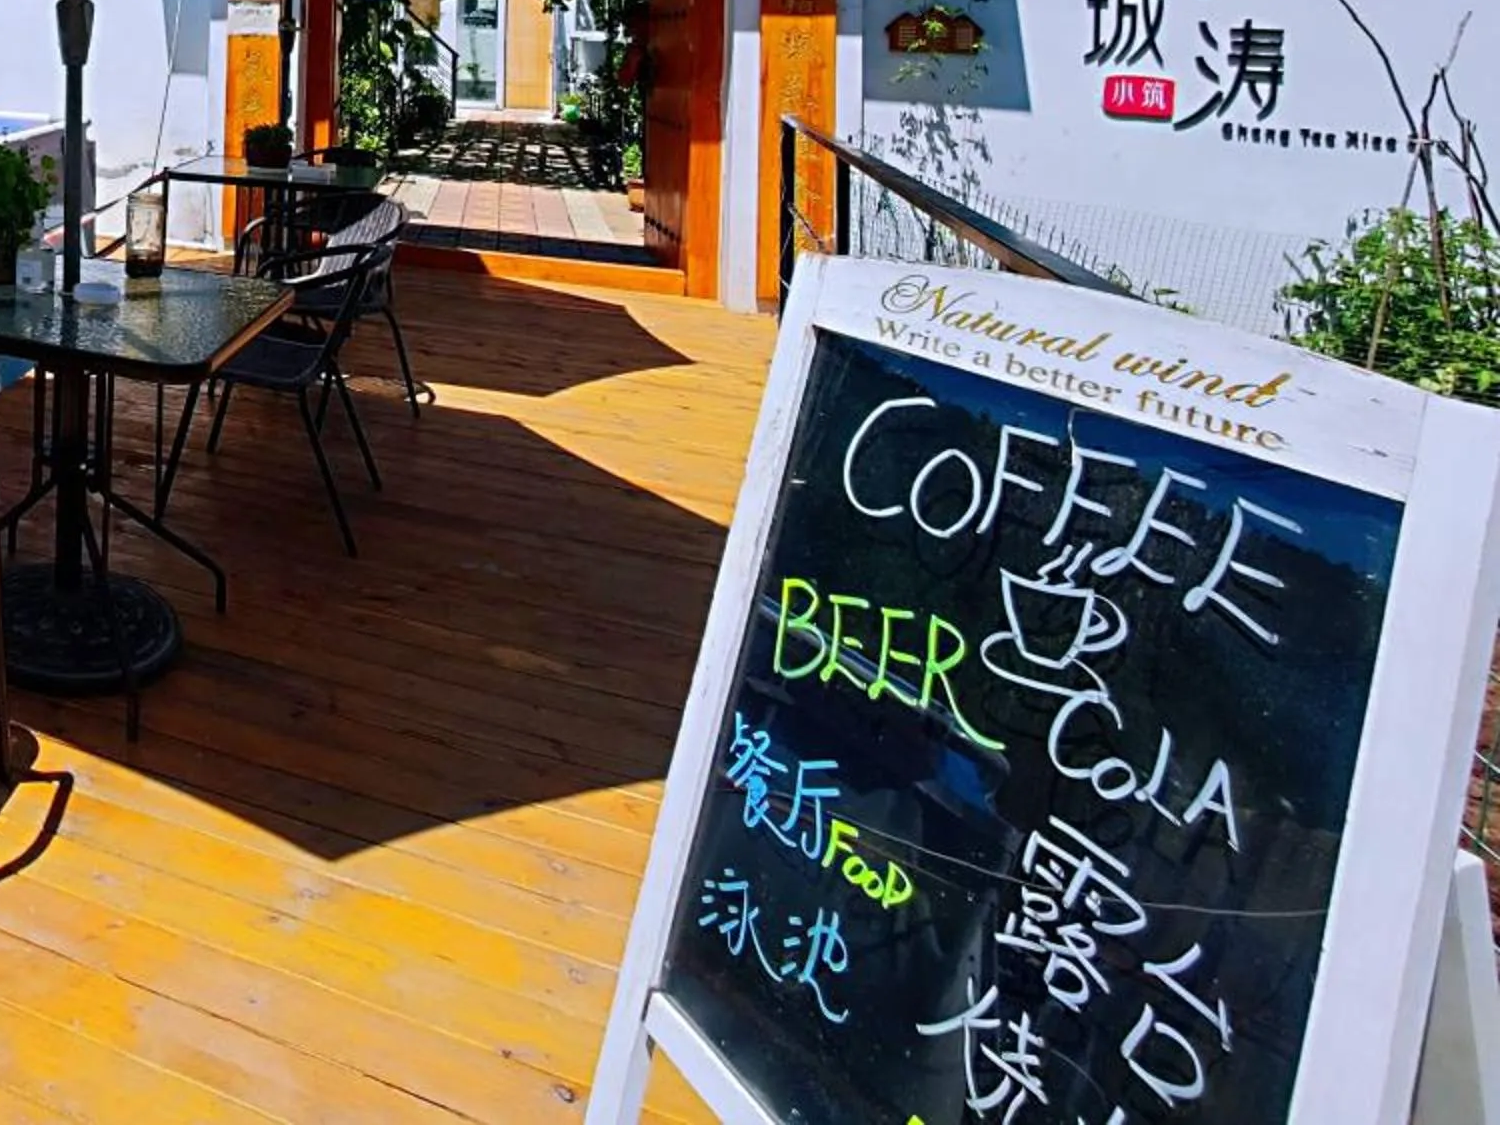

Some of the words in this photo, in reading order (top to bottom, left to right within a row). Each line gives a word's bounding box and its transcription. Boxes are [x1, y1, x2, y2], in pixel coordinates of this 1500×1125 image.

[1111, 80, 1168, 111] 小筑
[875, 317, 961, 358] Write
[972, 348, 991, 367] a
[1007, 354, 1122, 403] better
[1137, 390, 1289, 451] future
[881, 274, 1112, 363] Natural
[1113, 357, 1291, 408] wind
[844, 397, 1303, 645] COFFEE
[774, 578, 1005, 750] BEER
[726, 711, 840, 859] 餐厅
[698, 868, 850, 1023] 泳池
